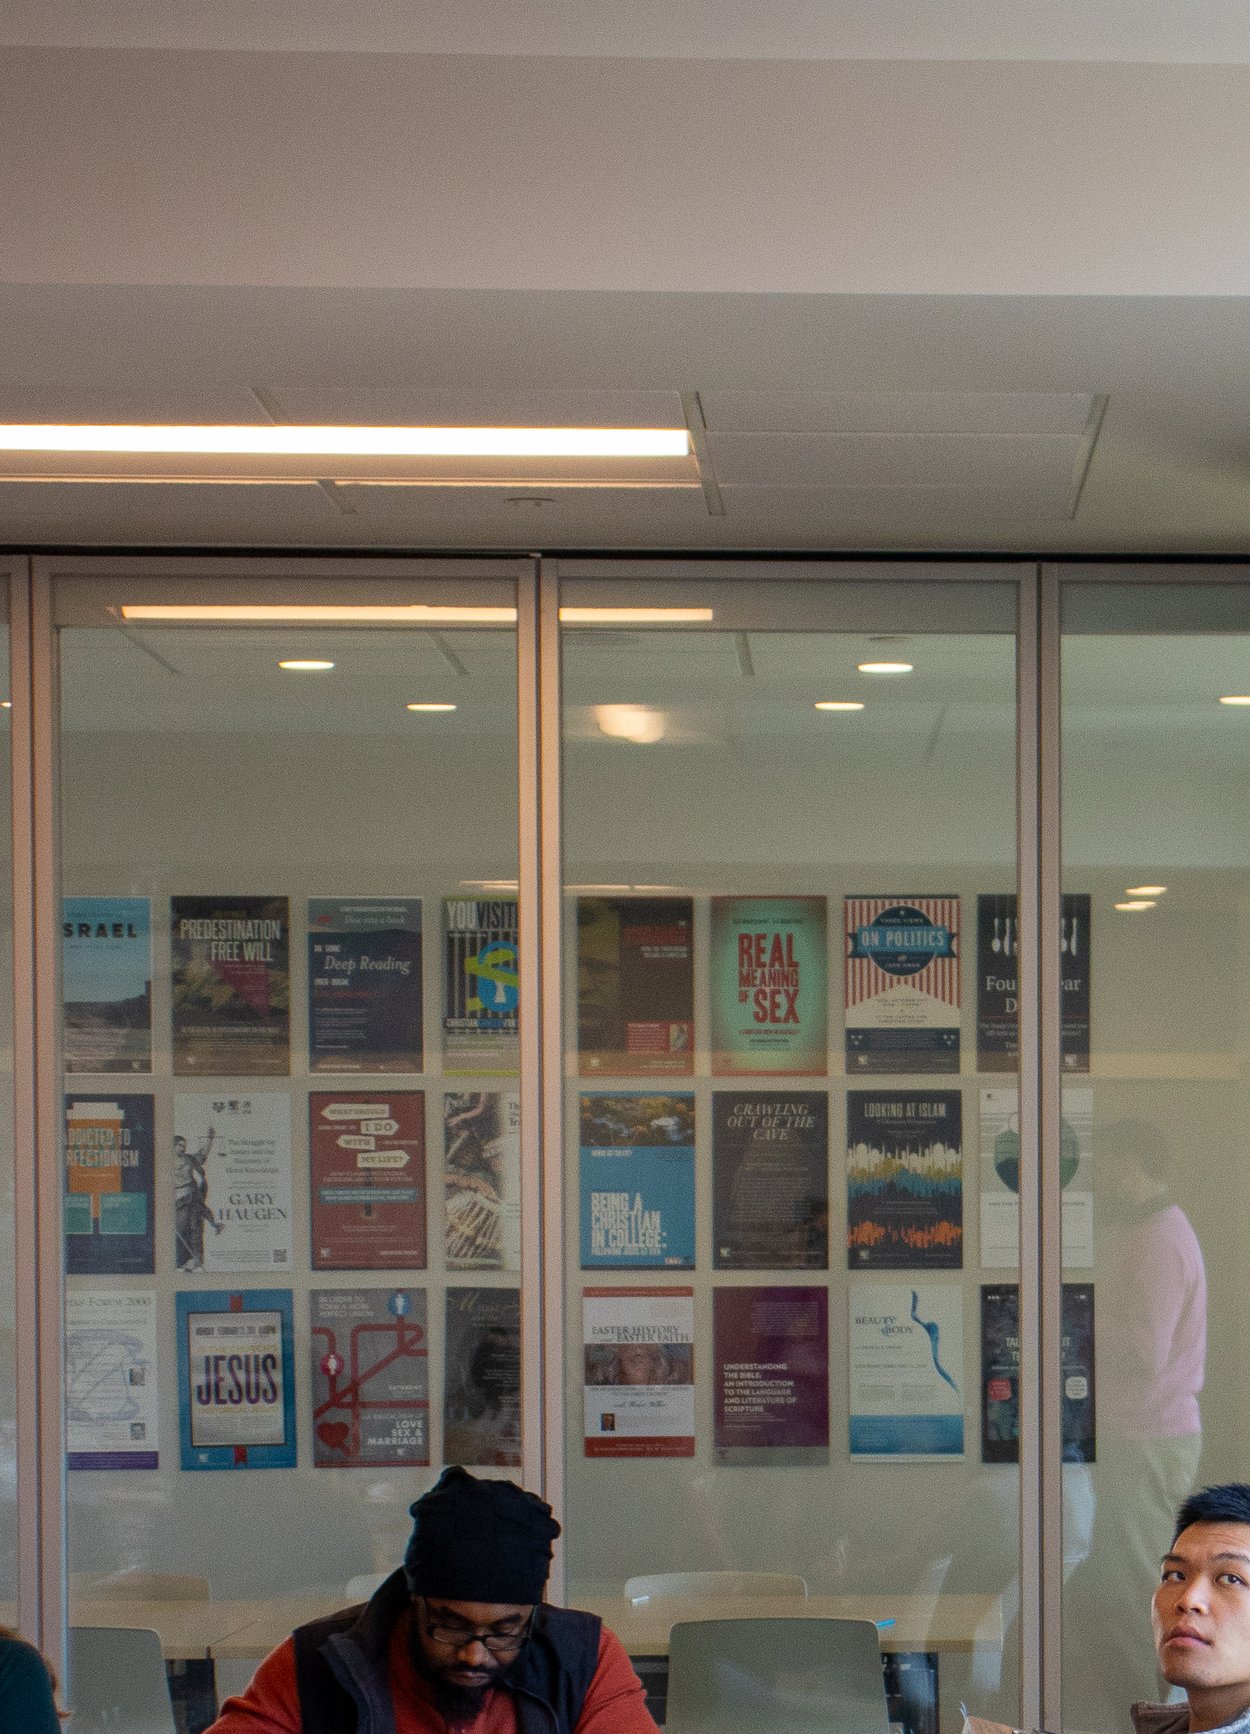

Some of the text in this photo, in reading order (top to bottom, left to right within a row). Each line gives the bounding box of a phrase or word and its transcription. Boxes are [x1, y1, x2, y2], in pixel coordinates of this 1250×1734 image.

[446, 901, 519, 929] YOU VISIT
[64, 922, 138, 940] SRAEL
[180, 919, 281, 940] PREDESTINATION
[861, 930, 945, 946] ON POLITICS
[211, 941, 274, 962] FREE WILL
[737, 932, 800, 968] REAL
[324, 955, 411, 975] Deep Reading
[737, 968, 800, 988] MEANING
[985, 975, 1082, 991] Fou ear
[738, 989, 749, 1004] OF
[752, 988, 801, 1024] SEX
[733, 1103, 809, 1116] CRAWLING
[863, 1102, 947, 1118] LOOKING AT ISLAM
[364, 1122, 370, 1132] I
[373, 1122, 393, 1132] DO
[727, 1115, 817, 1128] OUT OF THE
[67, 1127, 131, 1146] DDICTED TO
[343, 1138, 371, 1147] WITH
[752, 1128, 790, 1141] CAVE
[228, 1193, 275, 1206] GARY
[591, 1191, 643, 1212] BEING A
[218, 1207, 288, 1221] HAUGEN
[591, 1210, 661, 1230] CHRISTIAN
[591, 1229, 605, 1247] IN
[855, 1316, 897, 1325] BEAUTY
[591, 1325, 679, 1335] EASTER HISTORY
[616, 1332, 653, 1342] EASTER
[657, 1332, 689, 1342] FAITH
[196, 1353, 278, 1405] JESUS
[723, 1405, 764, 1413] SCRIPTURE
[391, 1428, 423, 1437] SEX &
[395, 1420, 423, 1429] LOVE
[366, 1436, 423, 1446] MARRIAGE
